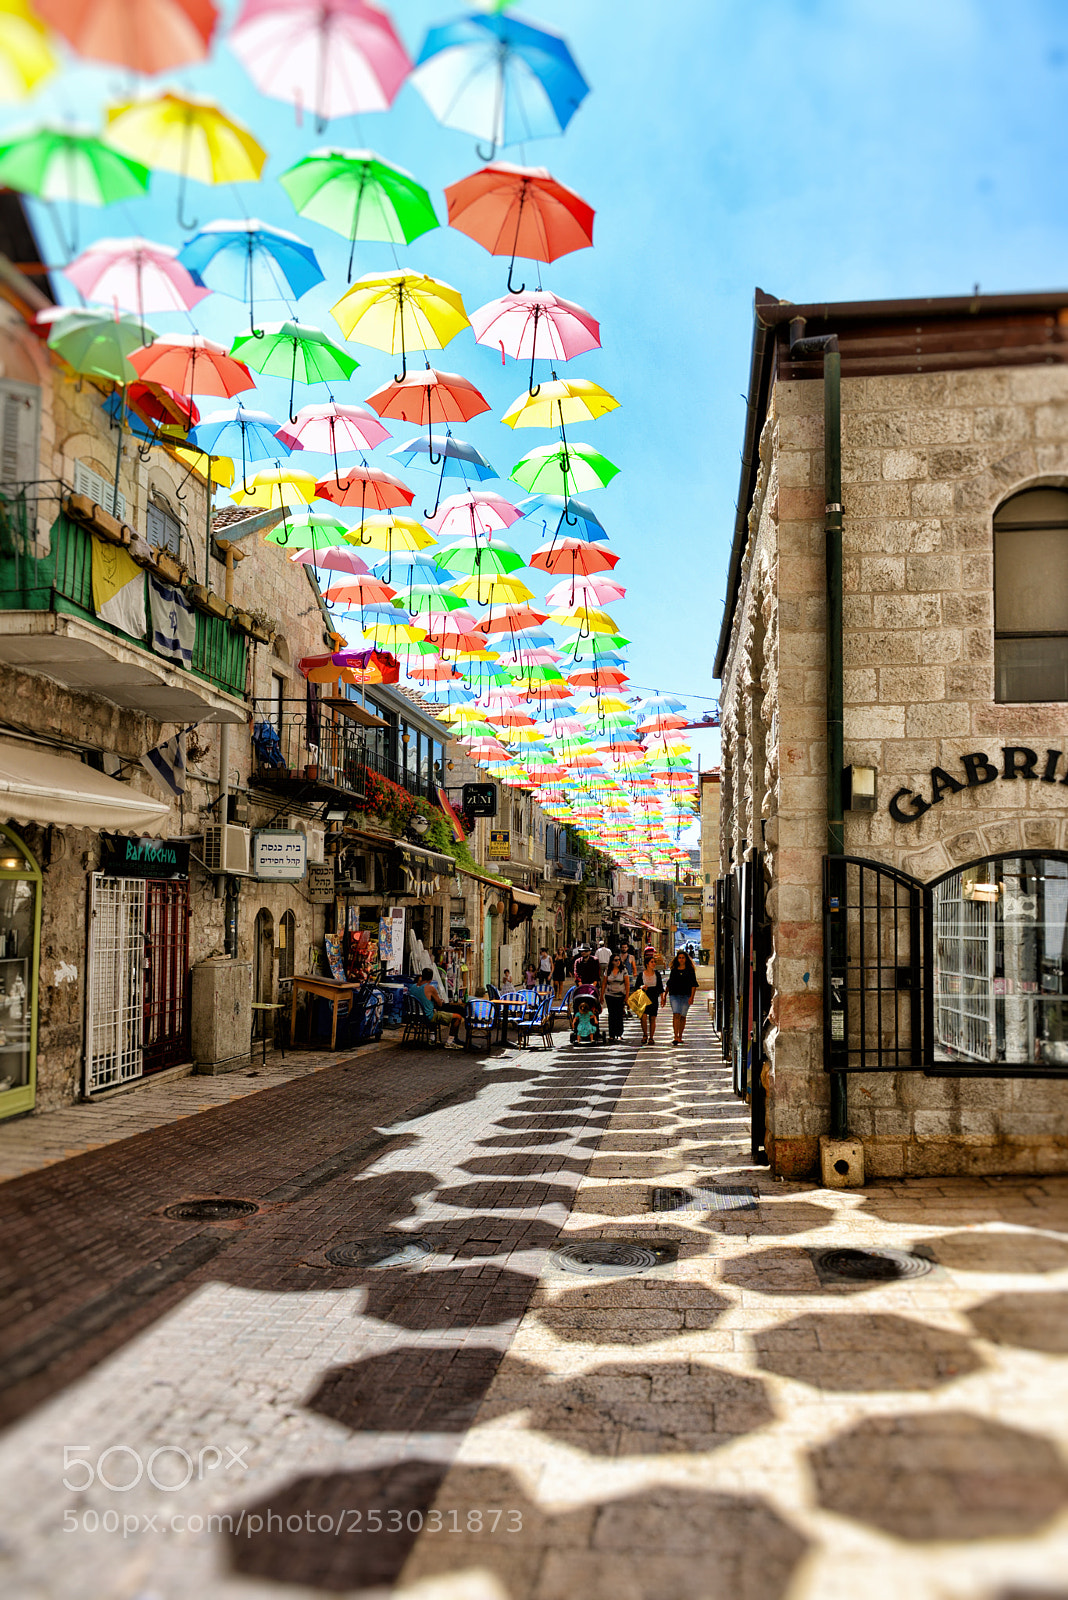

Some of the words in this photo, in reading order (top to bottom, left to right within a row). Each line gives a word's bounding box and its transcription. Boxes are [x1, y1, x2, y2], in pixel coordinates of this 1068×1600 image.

[889, 746, 1068, 823] GABRI
[260, 843, 283, 852] כנסת
[285, 844, 301, 852] בית
[286, 855, 301, 866] קהל
[314, 876, 331, 887] קהל
[310, 887, 334, 895] חסידים
